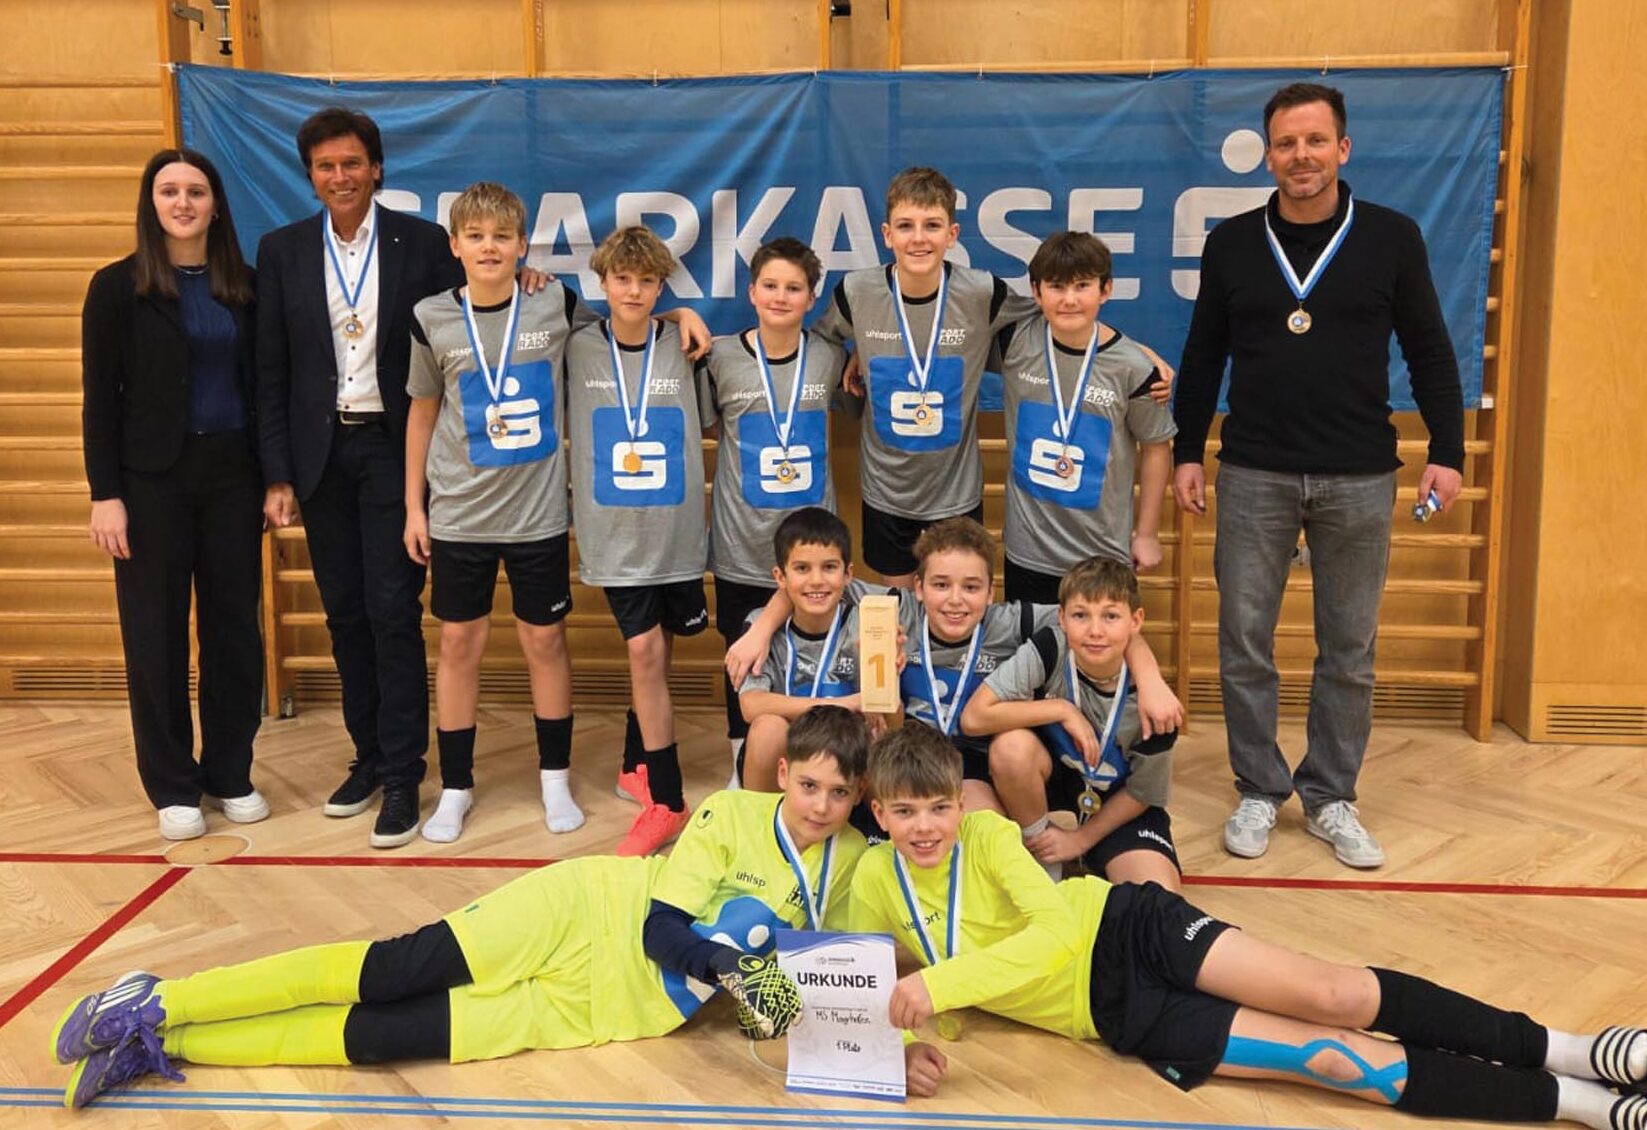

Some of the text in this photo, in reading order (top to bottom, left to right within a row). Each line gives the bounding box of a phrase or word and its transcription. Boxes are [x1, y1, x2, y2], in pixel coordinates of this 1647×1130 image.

[375, 186, 1143, 300] ARKASE
[868, 653, 887, 688] 1
[797, 971, 877, 989] URKUNDE
